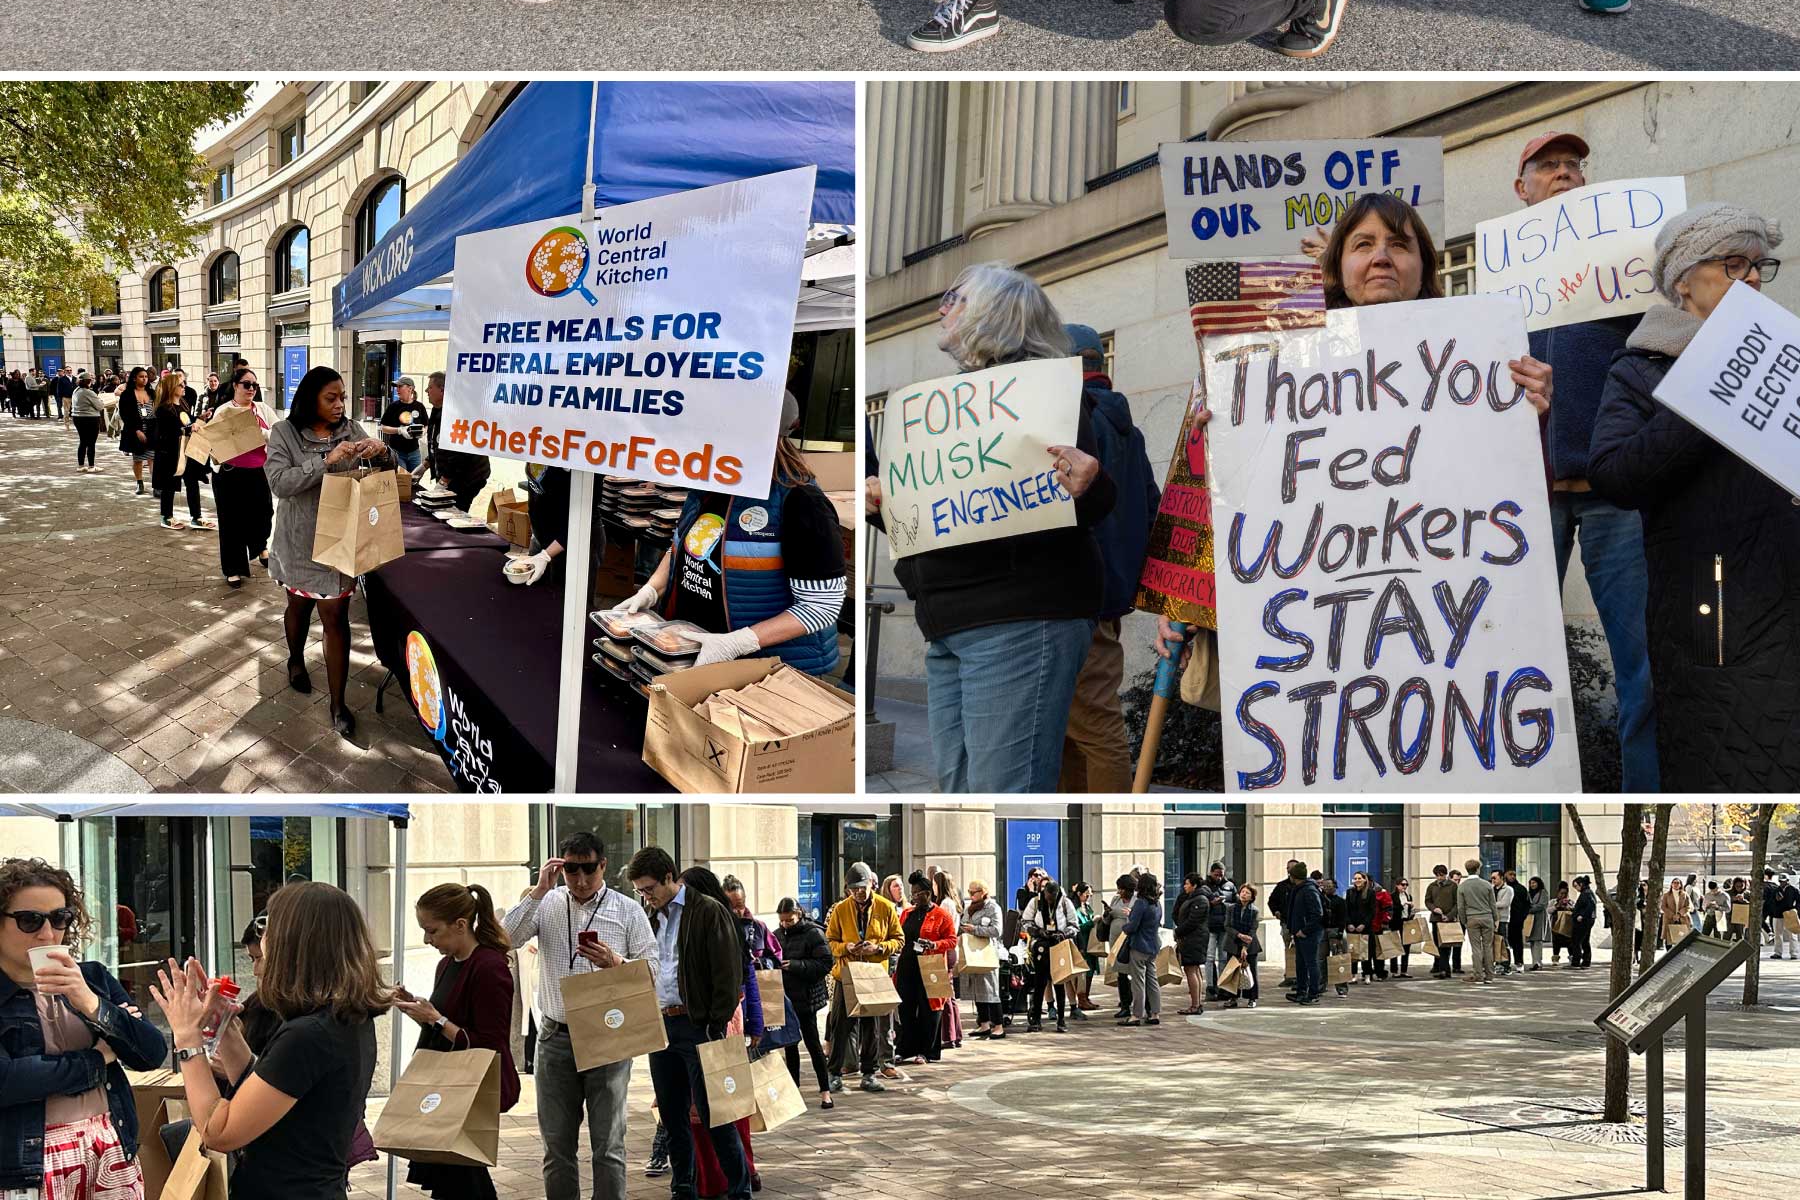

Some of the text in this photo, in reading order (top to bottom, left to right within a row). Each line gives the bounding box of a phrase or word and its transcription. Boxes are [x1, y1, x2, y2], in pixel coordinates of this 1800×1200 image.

[1183, 149, 1400, 196] HANDS OFF
[599, 221, 653, 247] World
[1191, 184, 1421, 241] OUR MON!
[1483, 189, 1664, 274] USAID
[362, 226, 414, 299] WCK.ORG
[596, 264, 669, 287] Kitchen
[598, 241, 667, 267] Central
[1558, 263, 1590, 303] the
[483, 311, 722, 344] FREE MEALS FOR
[457, 351, 765, 380] FEDERAL EMPLOYEES
[1215, 340, 1409, 427] Thank
[1709, 322, 1772, 406] NOBODY
[1741, 343, 1800, 432] ELECTED
[493, 382, 685, 416] AND FAMILIES
[901, 376, 1020, 443] FORK
[449, 419, 744, 486] #ChefsForFeds
[888, 431, 1013, 497] MUSK
[1281, 424, 1422, 504] Fed
[1161, 488, 1211, 519] DESTROY
[684, 553, 704, 574] World
[1172, 531, 1197, 552] OUR
[682, 565, 712, 588] Central
[1142, 561, 1215, 603] DEMOCRACY
[1254, 576, 1492, 673] STAY
[448, 686, 493, 762] World
[1237, 666, 1554, 791] STRONG
[1026, 833, 1041, 843] PRP
